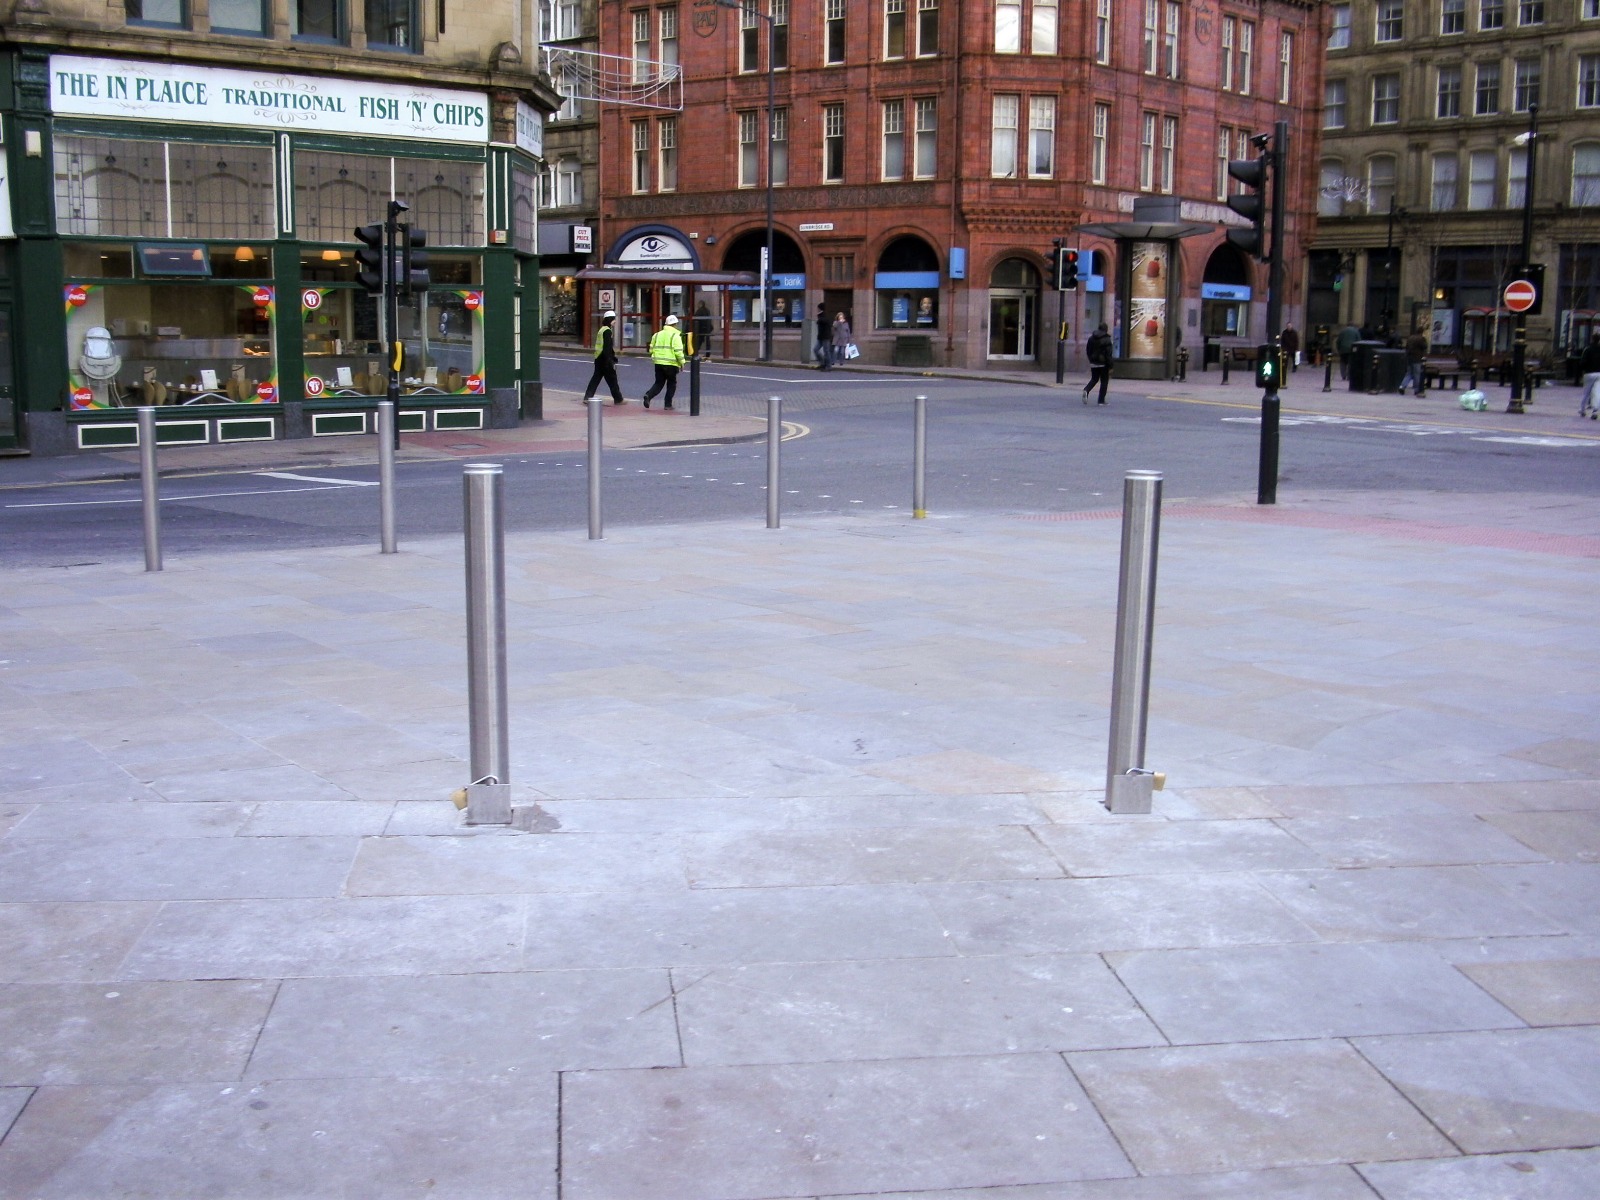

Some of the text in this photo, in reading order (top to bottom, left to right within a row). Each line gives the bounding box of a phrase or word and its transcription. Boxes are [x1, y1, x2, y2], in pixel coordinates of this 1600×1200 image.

[56, 72, 99, 97] THE
[107, 75, 128, 99] IN
[136, 77, 208, 105] PLAICE
[222, 88, 346, 113] TRADITIONAL
[359, 96, 399, 120] FISH
[433, 103, 484, 127] CHIPS
[784, 277, 801, 286] bank
